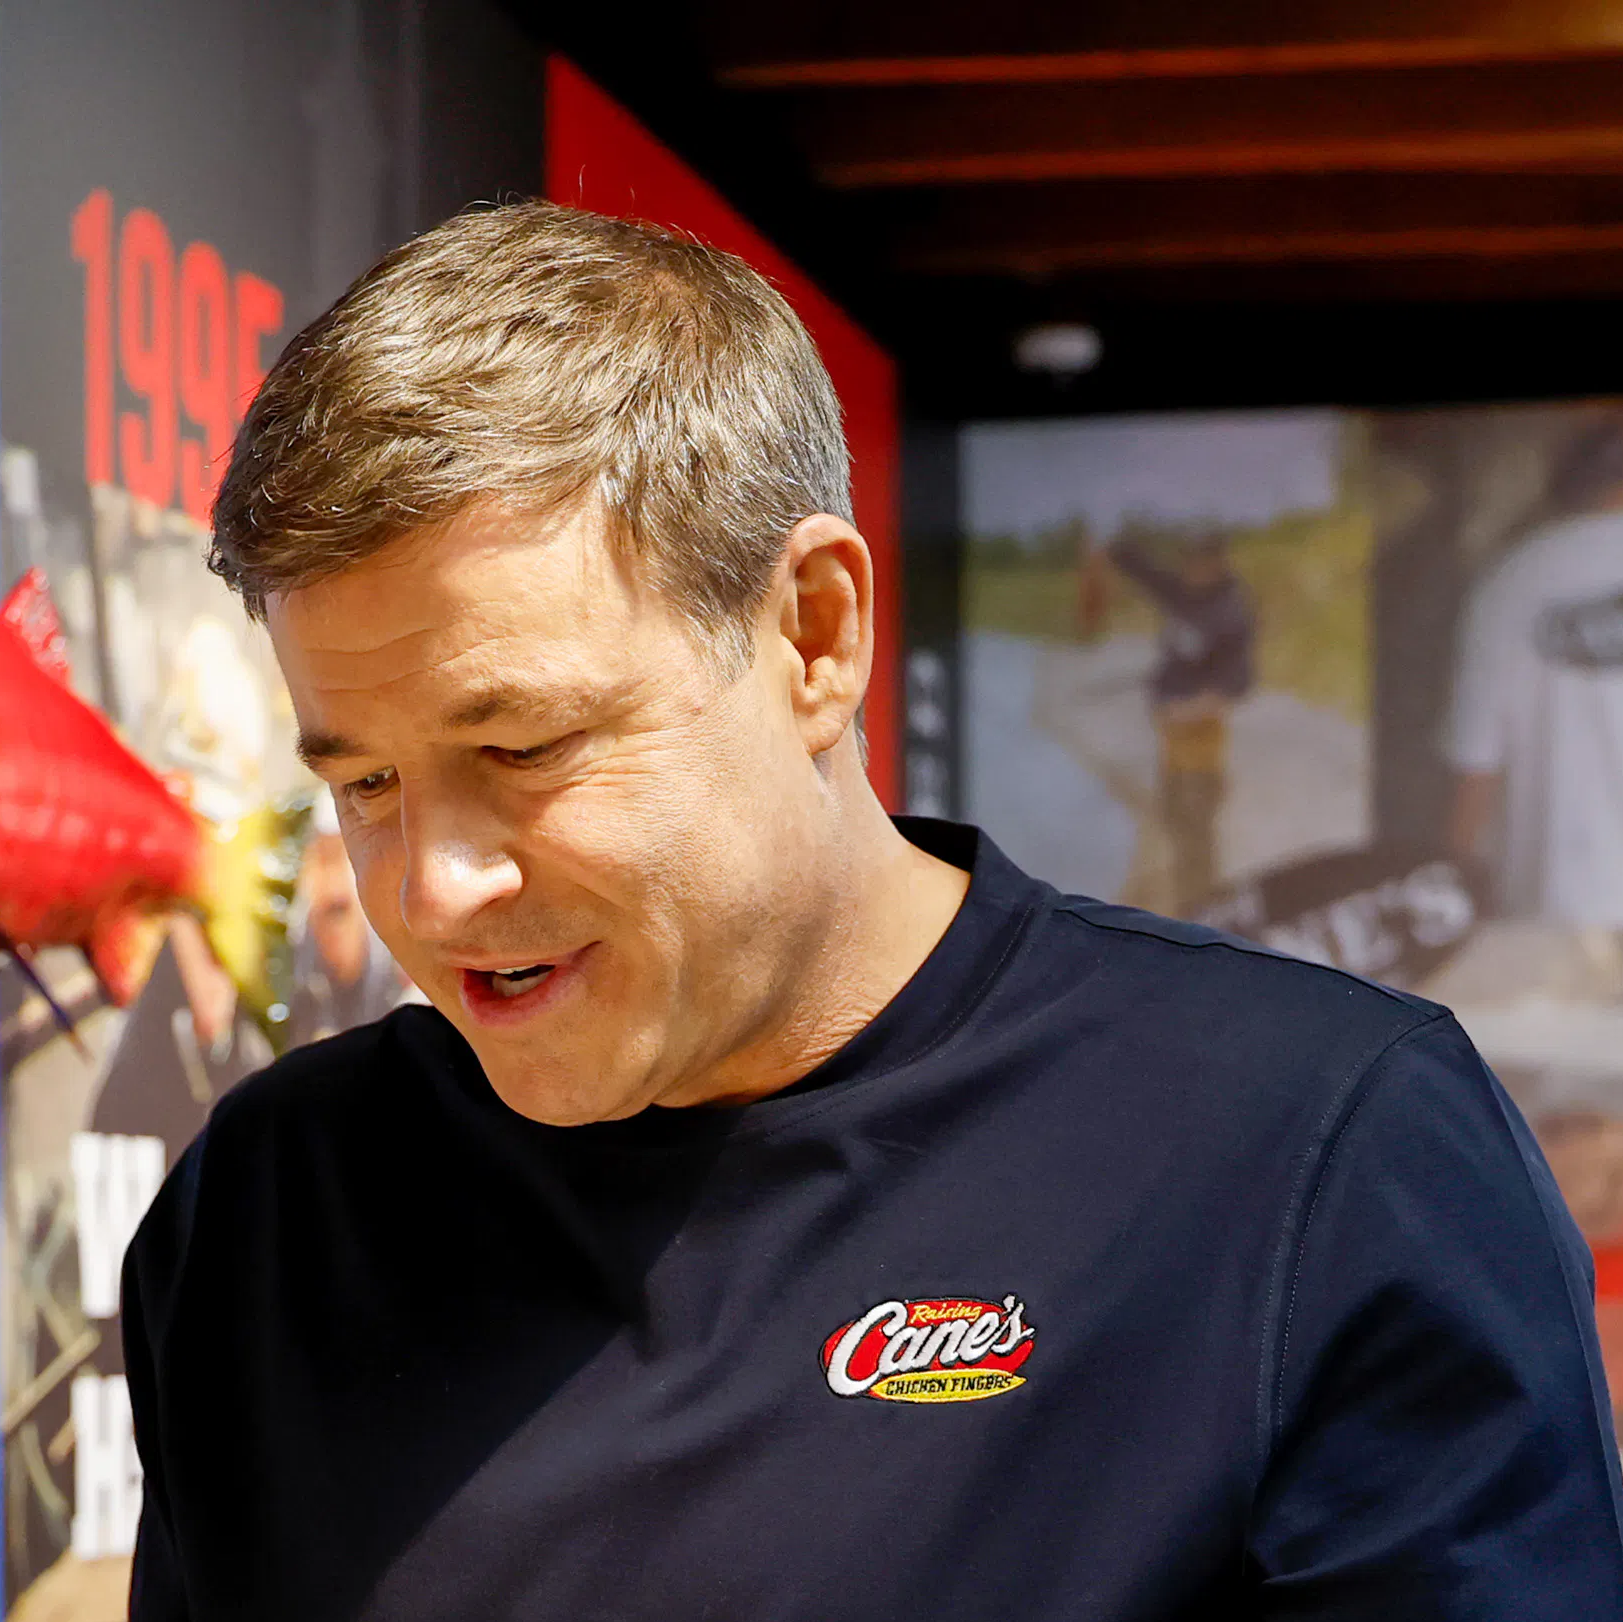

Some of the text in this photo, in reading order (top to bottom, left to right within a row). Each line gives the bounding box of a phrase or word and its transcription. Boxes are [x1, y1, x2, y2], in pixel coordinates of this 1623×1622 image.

[910, 1302, 984, 1325] Raising
[827, 1294, 1035, 1395] Cane's
[886, 1375, 1013, 1396] CHICKEN FINGERS
